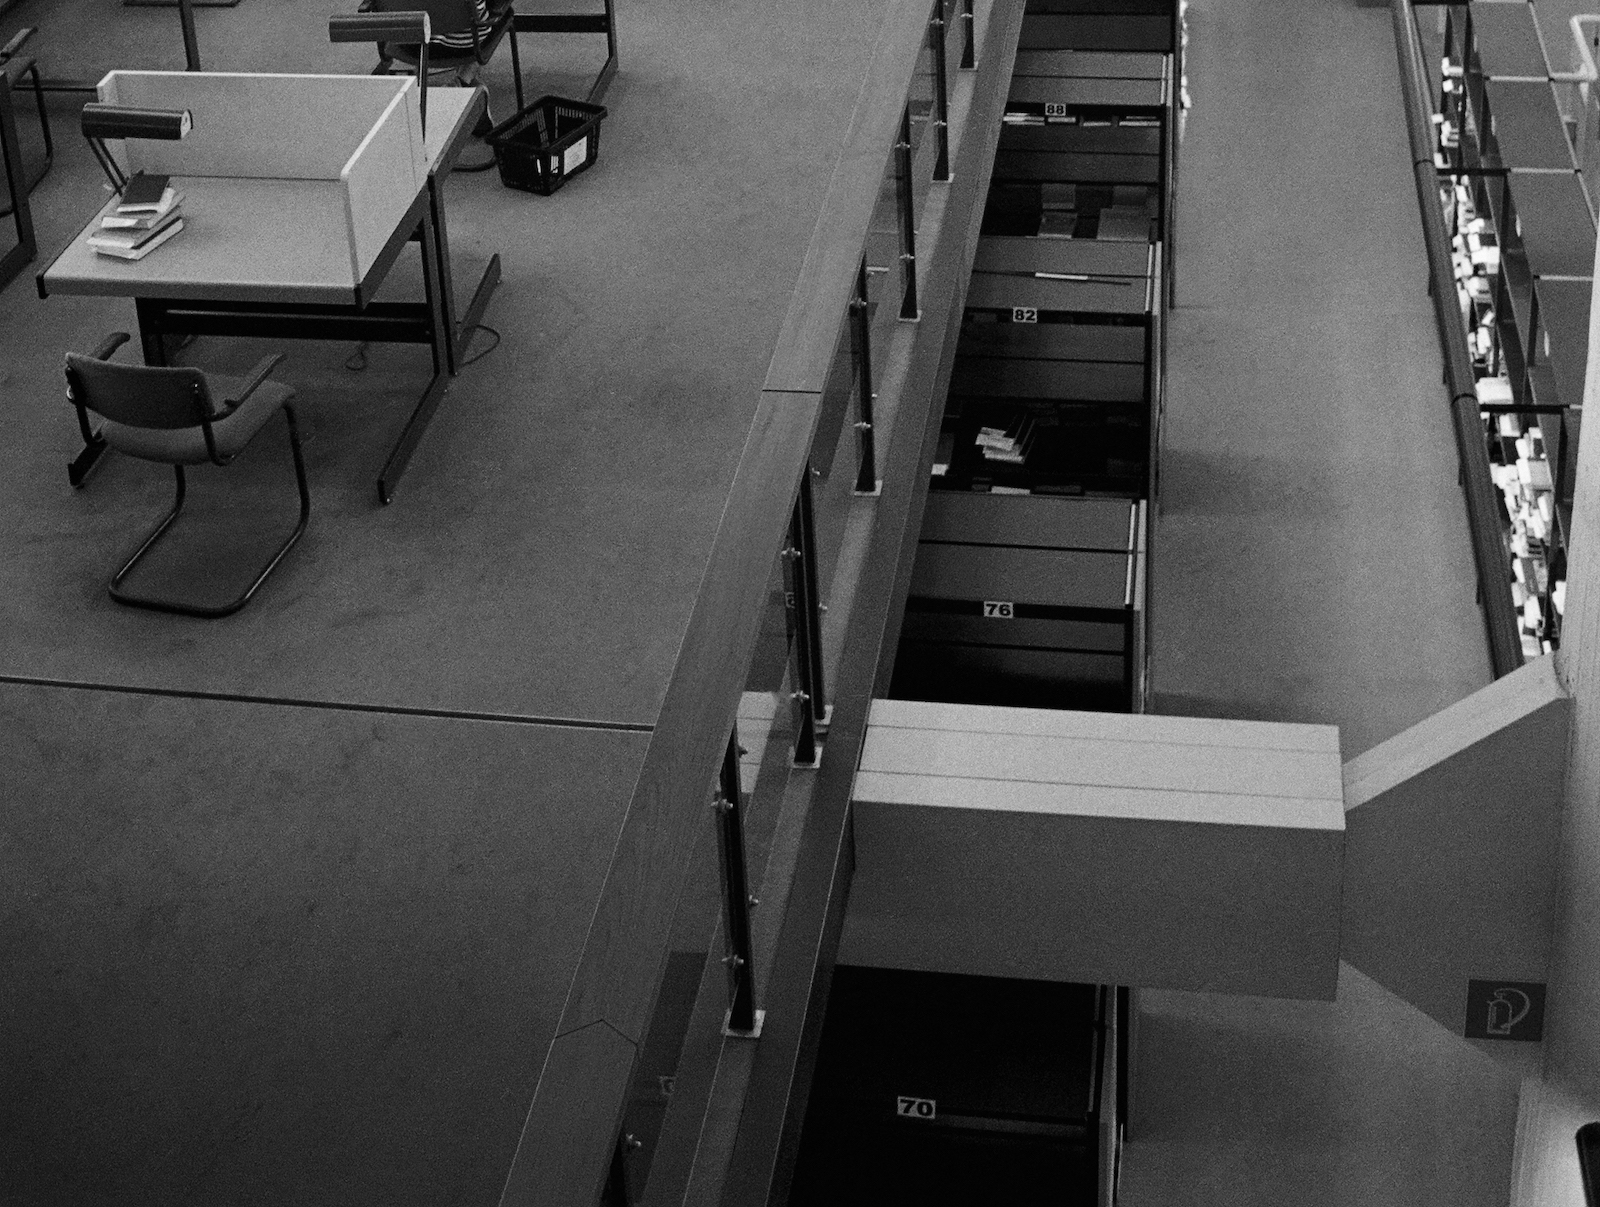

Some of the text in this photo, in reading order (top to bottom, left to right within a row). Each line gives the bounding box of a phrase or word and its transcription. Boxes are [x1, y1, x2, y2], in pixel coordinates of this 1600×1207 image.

[1046, 104, 1065, 115] 88
[1014, 309, 1036, 321] 82
[985, 603, 1012, 616] 76
[899, 1098, 934, 1116] 70
